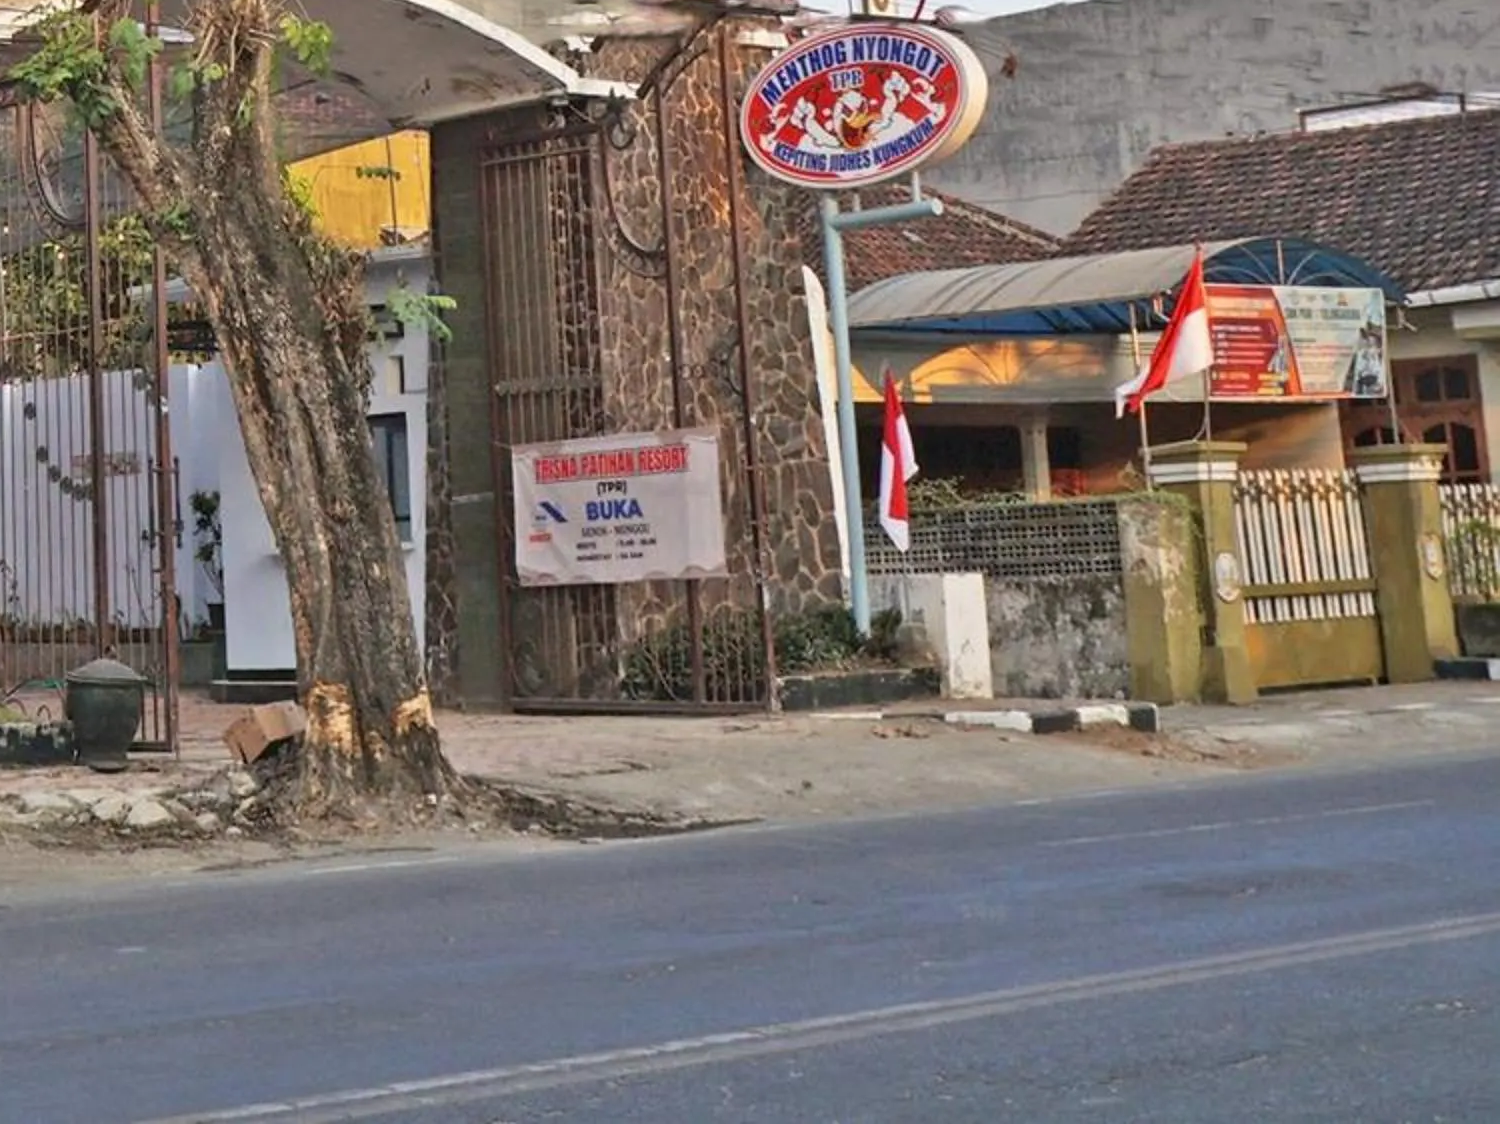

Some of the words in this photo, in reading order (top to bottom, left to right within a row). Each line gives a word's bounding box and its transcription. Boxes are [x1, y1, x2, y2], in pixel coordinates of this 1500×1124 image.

[761, 40, 847, 106] MENTHOG
[852, 36, 945, 77] NYONGOT
[831, 70, 863, 90] TPR
[873, 117, 934, 164] KUNGKUM
[535, 458, 579, 484] TRISNA
[581, 449, 635, 479] PATIHAN
[639, 444, 689, 474] RESORT
[596, 481, 627, 496] (TPR)
[585, 498, 644, 521] BUKA
